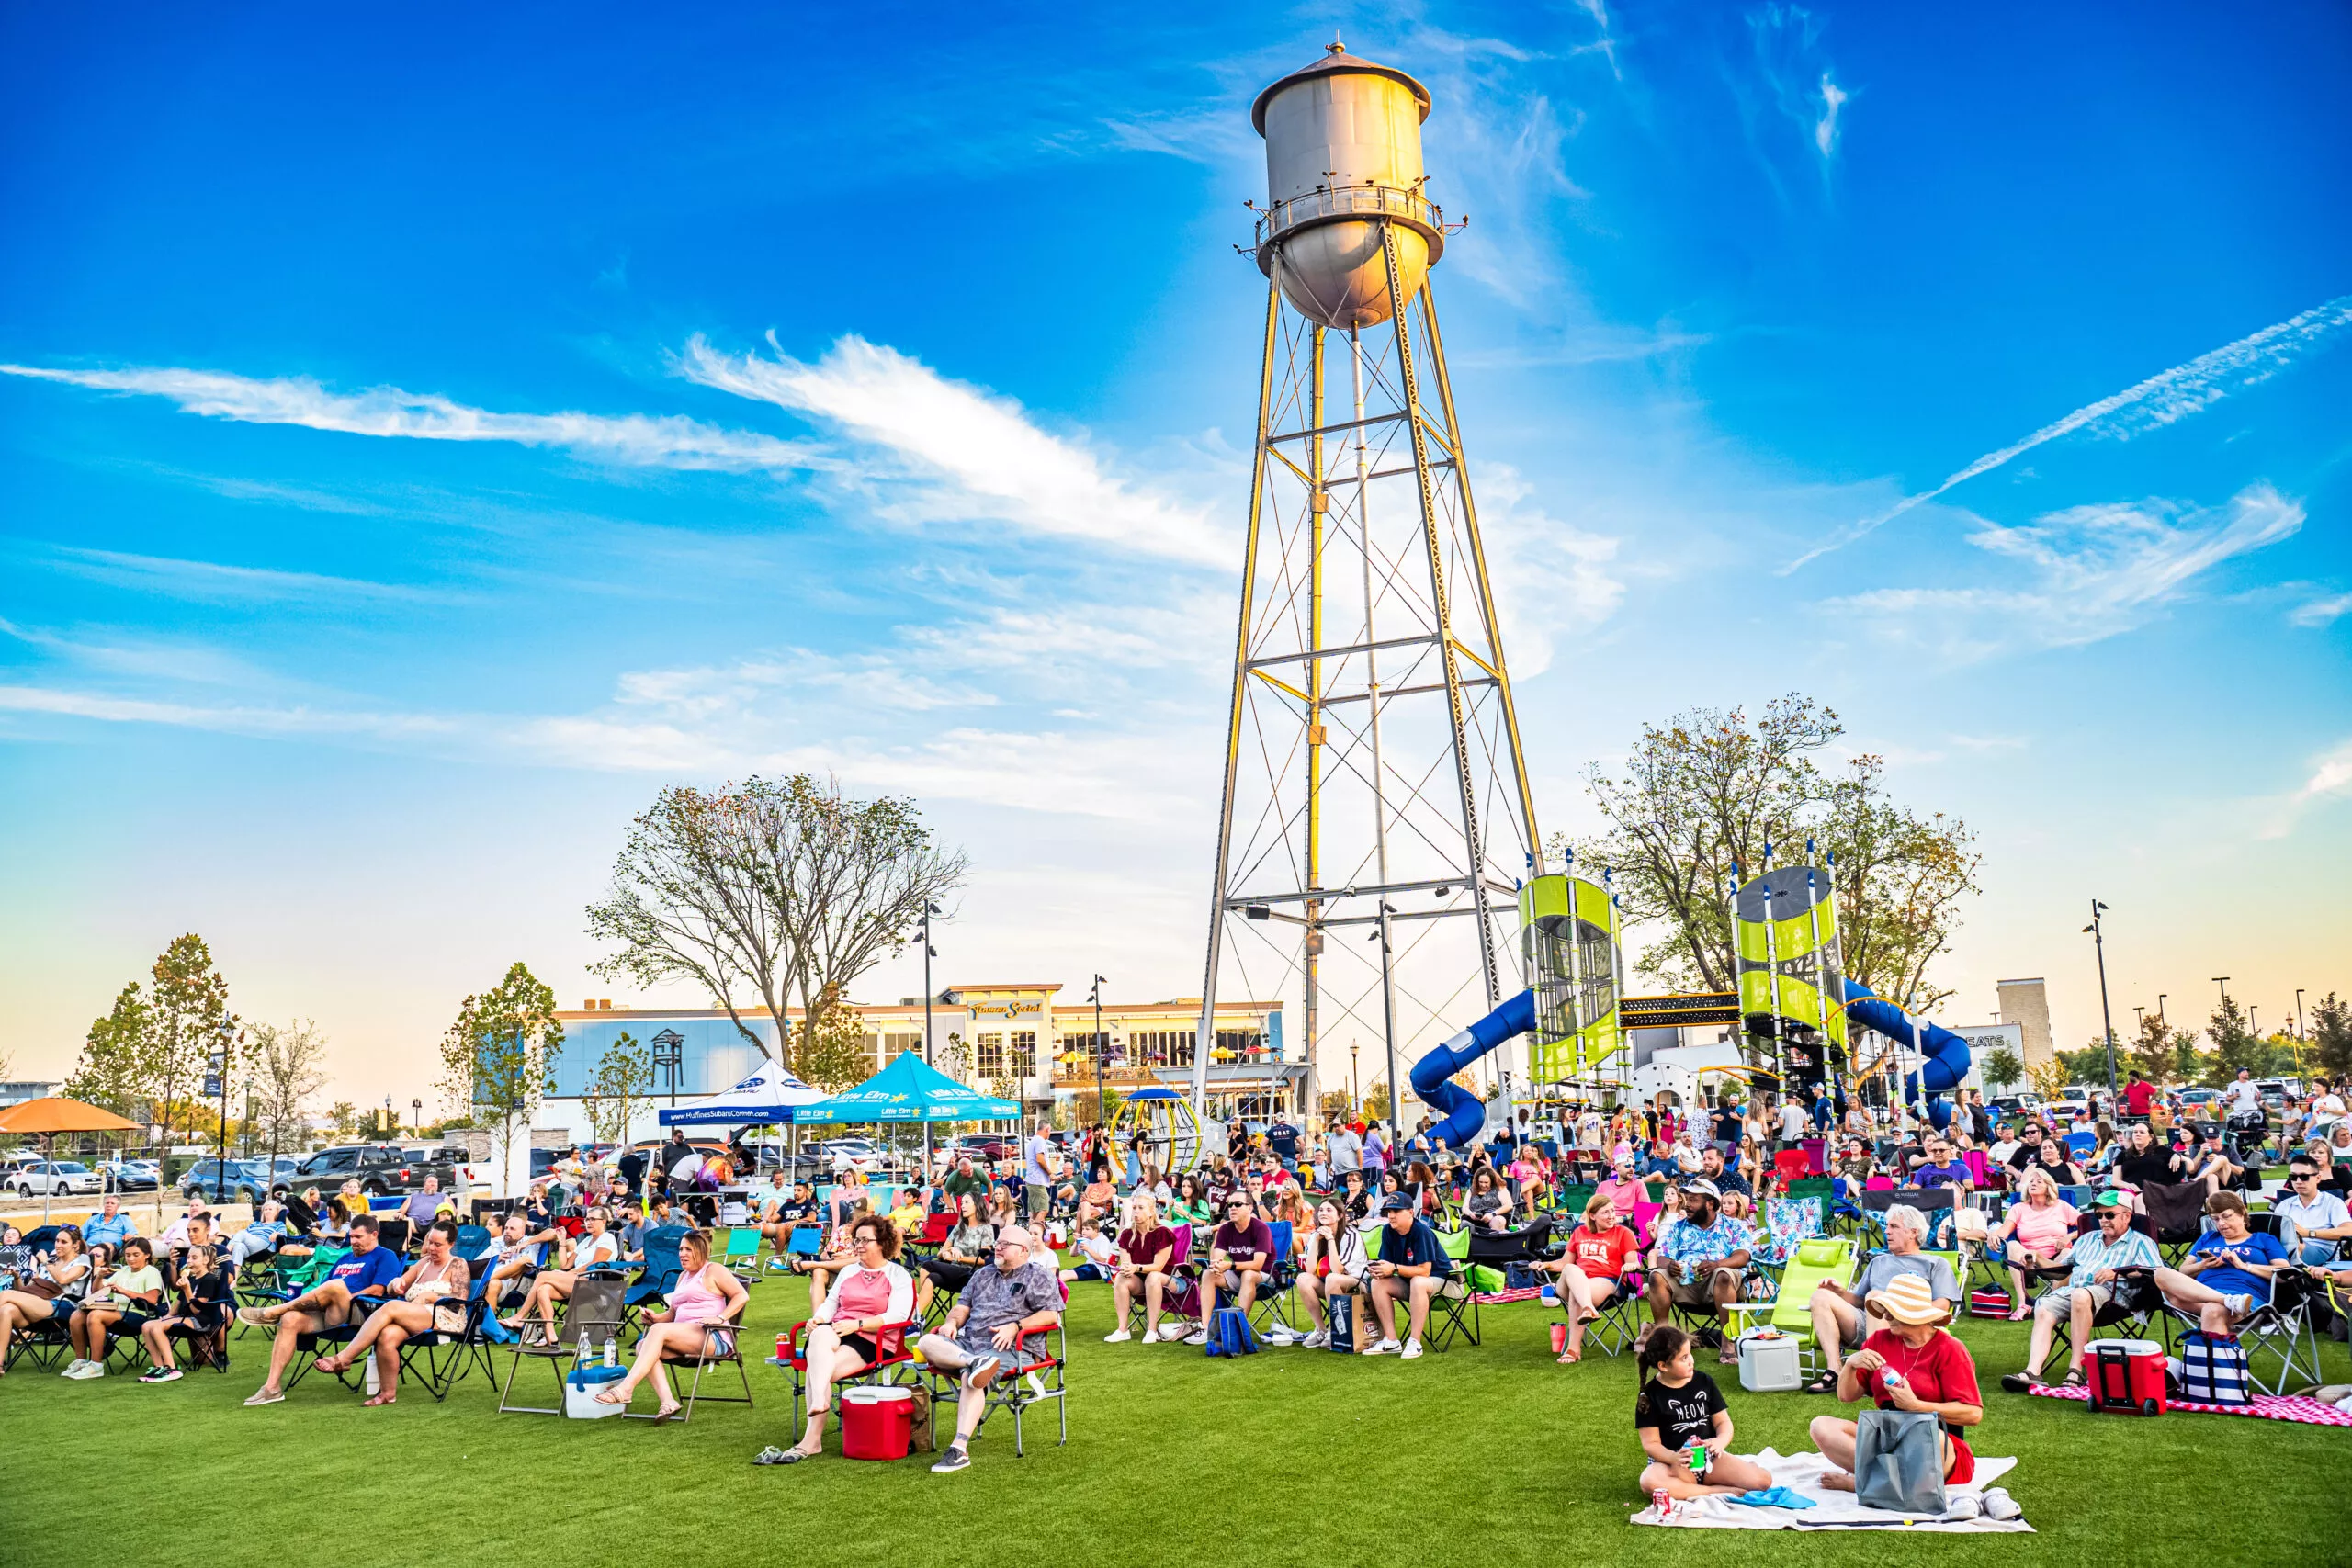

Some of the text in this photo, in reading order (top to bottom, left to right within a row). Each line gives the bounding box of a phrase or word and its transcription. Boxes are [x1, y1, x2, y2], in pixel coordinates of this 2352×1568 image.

[970, 1001, 1043, 1020] Tinman Social
[1966, 1035, 2004, 1047] EATS
[864, 1090, 890, 1100] Elm
[670, 1110, 769, 1121] www.HuffinesSubaruCorinth.com
[1579, 1243, 1608, 1259] USA
[1675, 1402, 1706, 1421] MEOW
